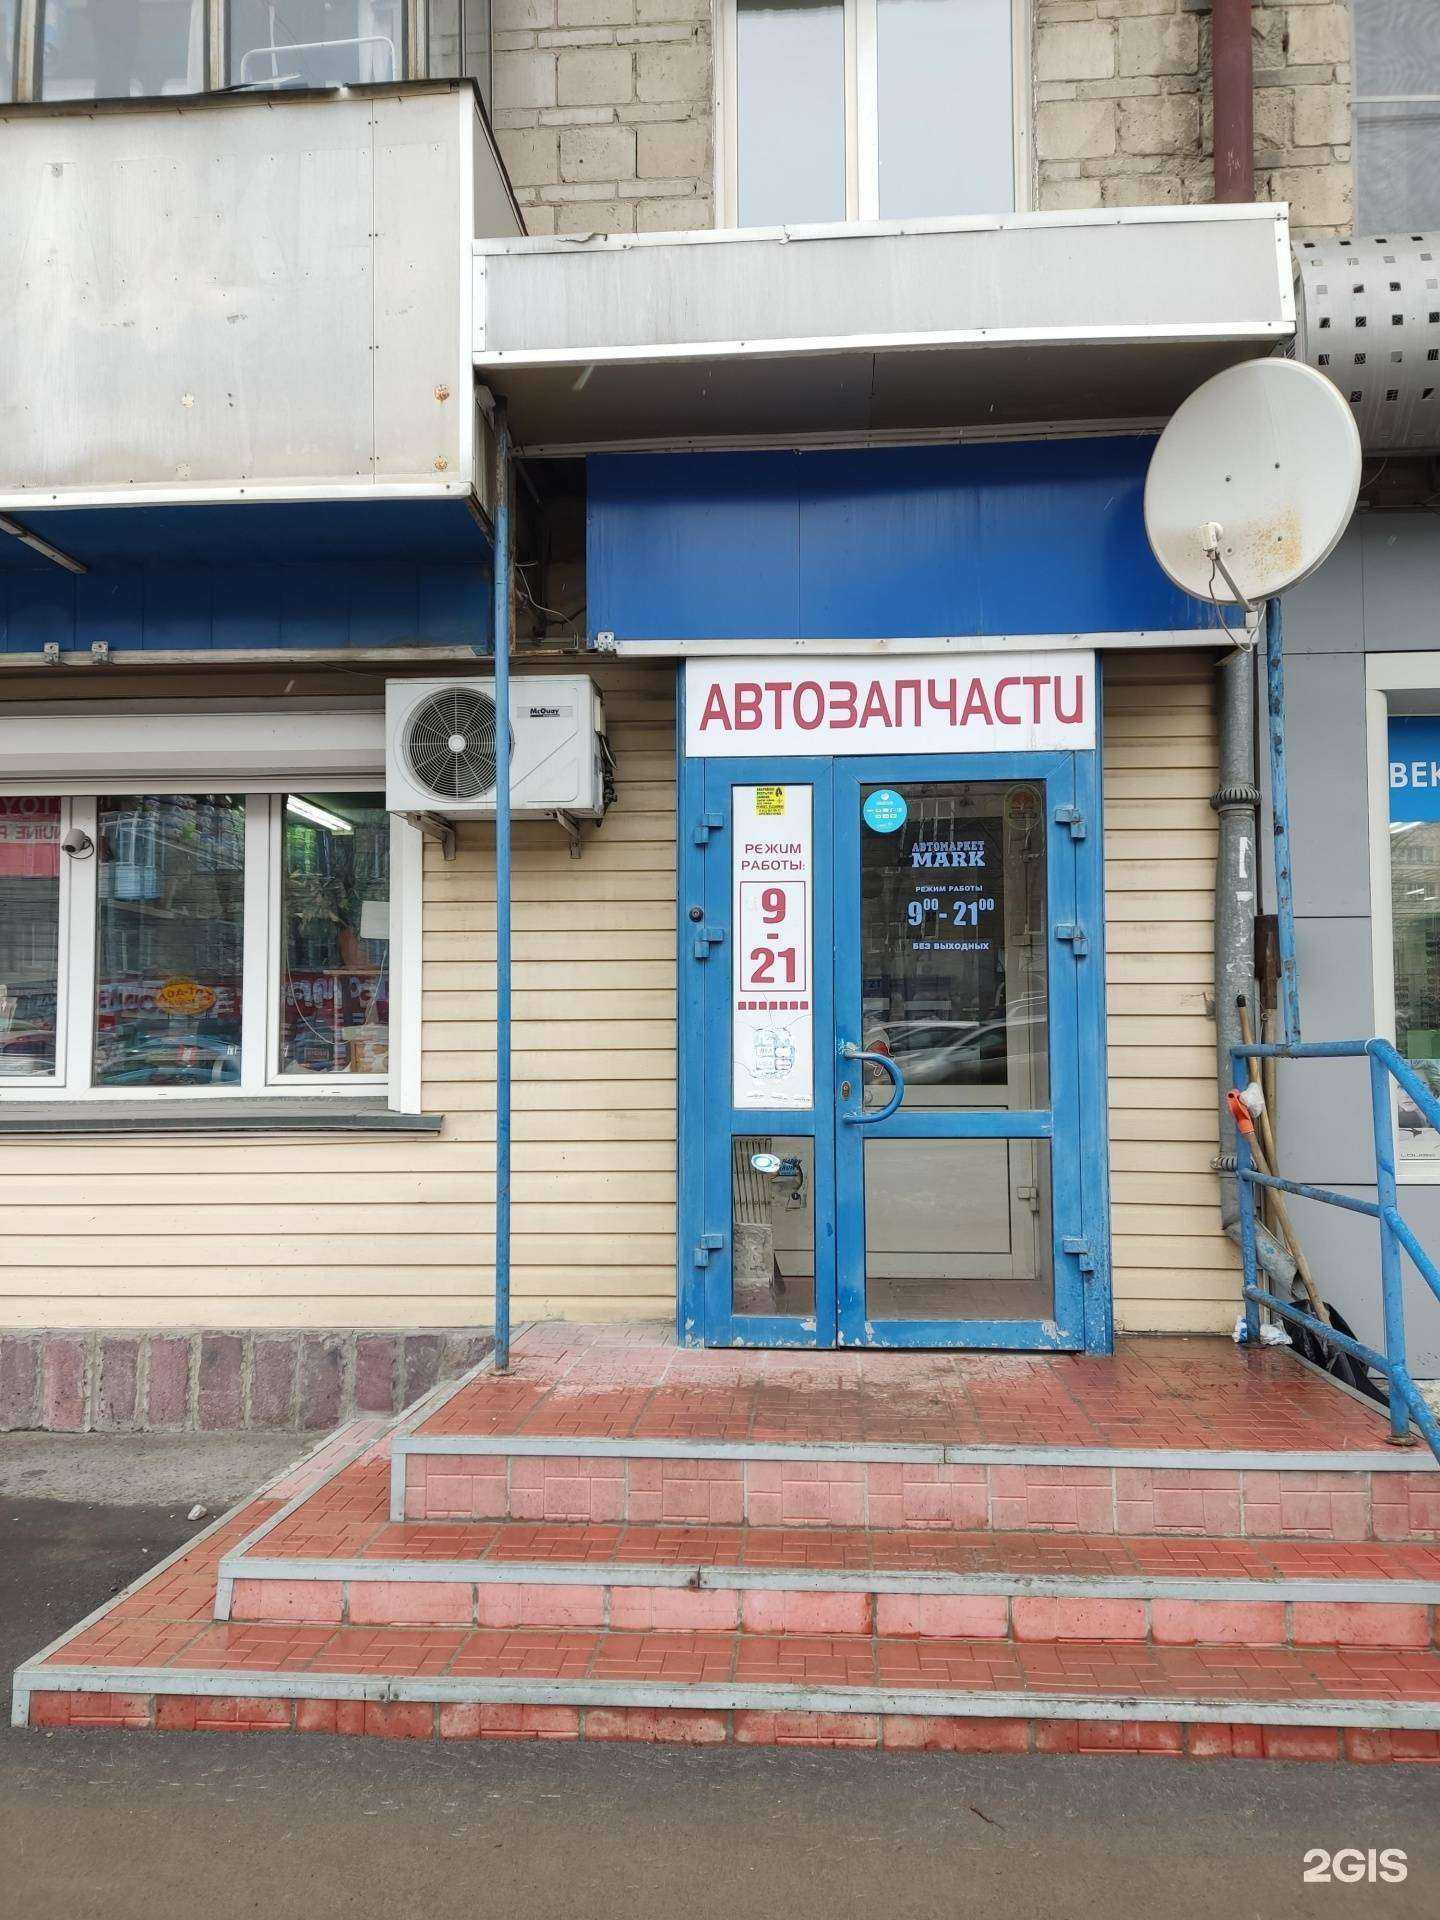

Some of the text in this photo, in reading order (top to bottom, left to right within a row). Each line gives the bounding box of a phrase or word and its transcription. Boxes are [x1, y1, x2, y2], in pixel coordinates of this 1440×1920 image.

[699, 675, 1083, 731] АВТОЗАПЧАСТИ
[745, 843, 801, 854] РЕЖИМ
[912, 841, 985, 851] АВТОМАРКЕТ
[741, 860, 805, 870] РАБОТЫ:
[761, 888, 786, 924] 9
[934, 942, 989, 950] ВЫХОДНЫХ
[750, 947, 796, 983] 21
